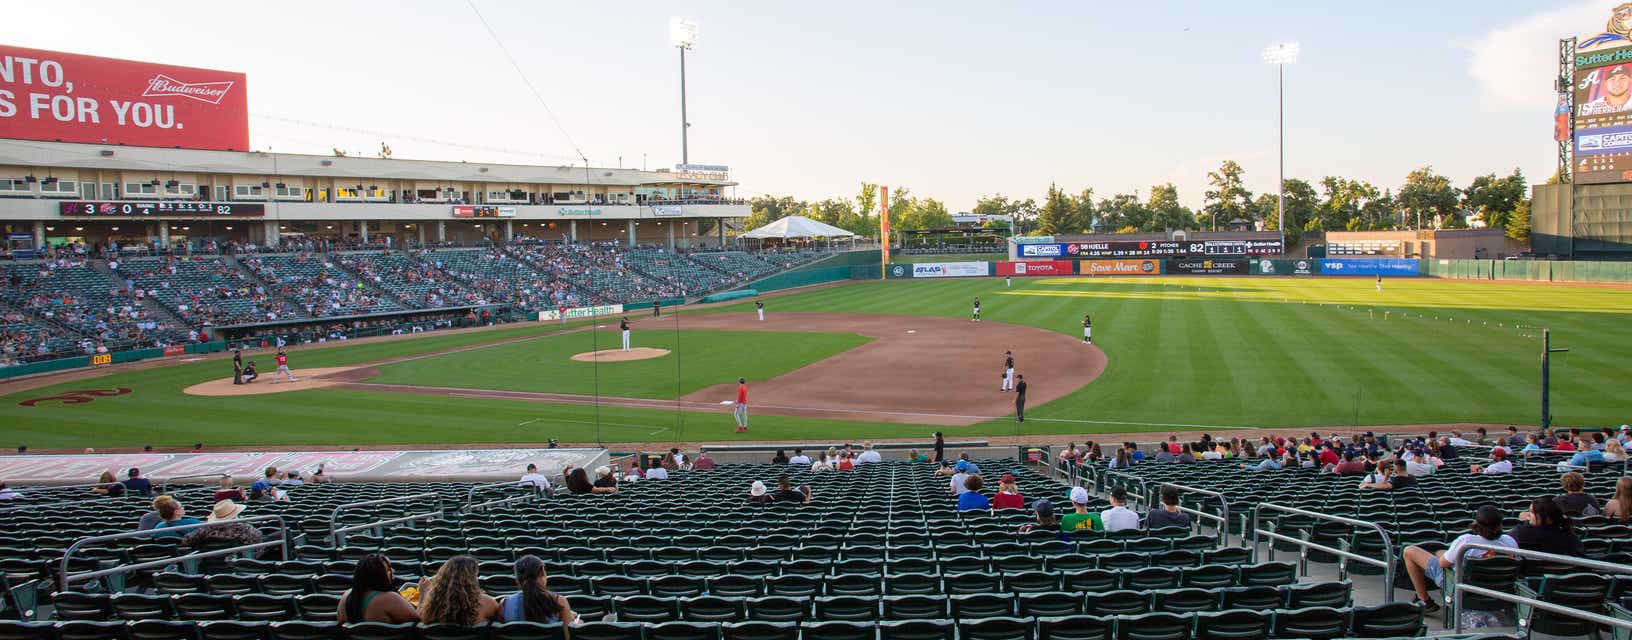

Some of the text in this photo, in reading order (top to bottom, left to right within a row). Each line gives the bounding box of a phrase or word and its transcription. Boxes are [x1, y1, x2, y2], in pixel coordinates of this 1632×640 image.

[1576, 53, 1616, 66] Sutter
[149, 77, 224, 97] Budweiser
[30, 92, 100, 124] FOR
[110, 100, 184, 129] YOU.
[85, 204, 95, 214] 3
[122, 204, 132, 214] 0
[217, 205, 231, 215] 82
[1190, 243, 1204, 253] 82
[1090, 262, 1112, 272] Save
[1113, 261, 1139, 271] Mart
[1325, 262, 1343, 270] vsp
[587, 305, 615, 316] Health
